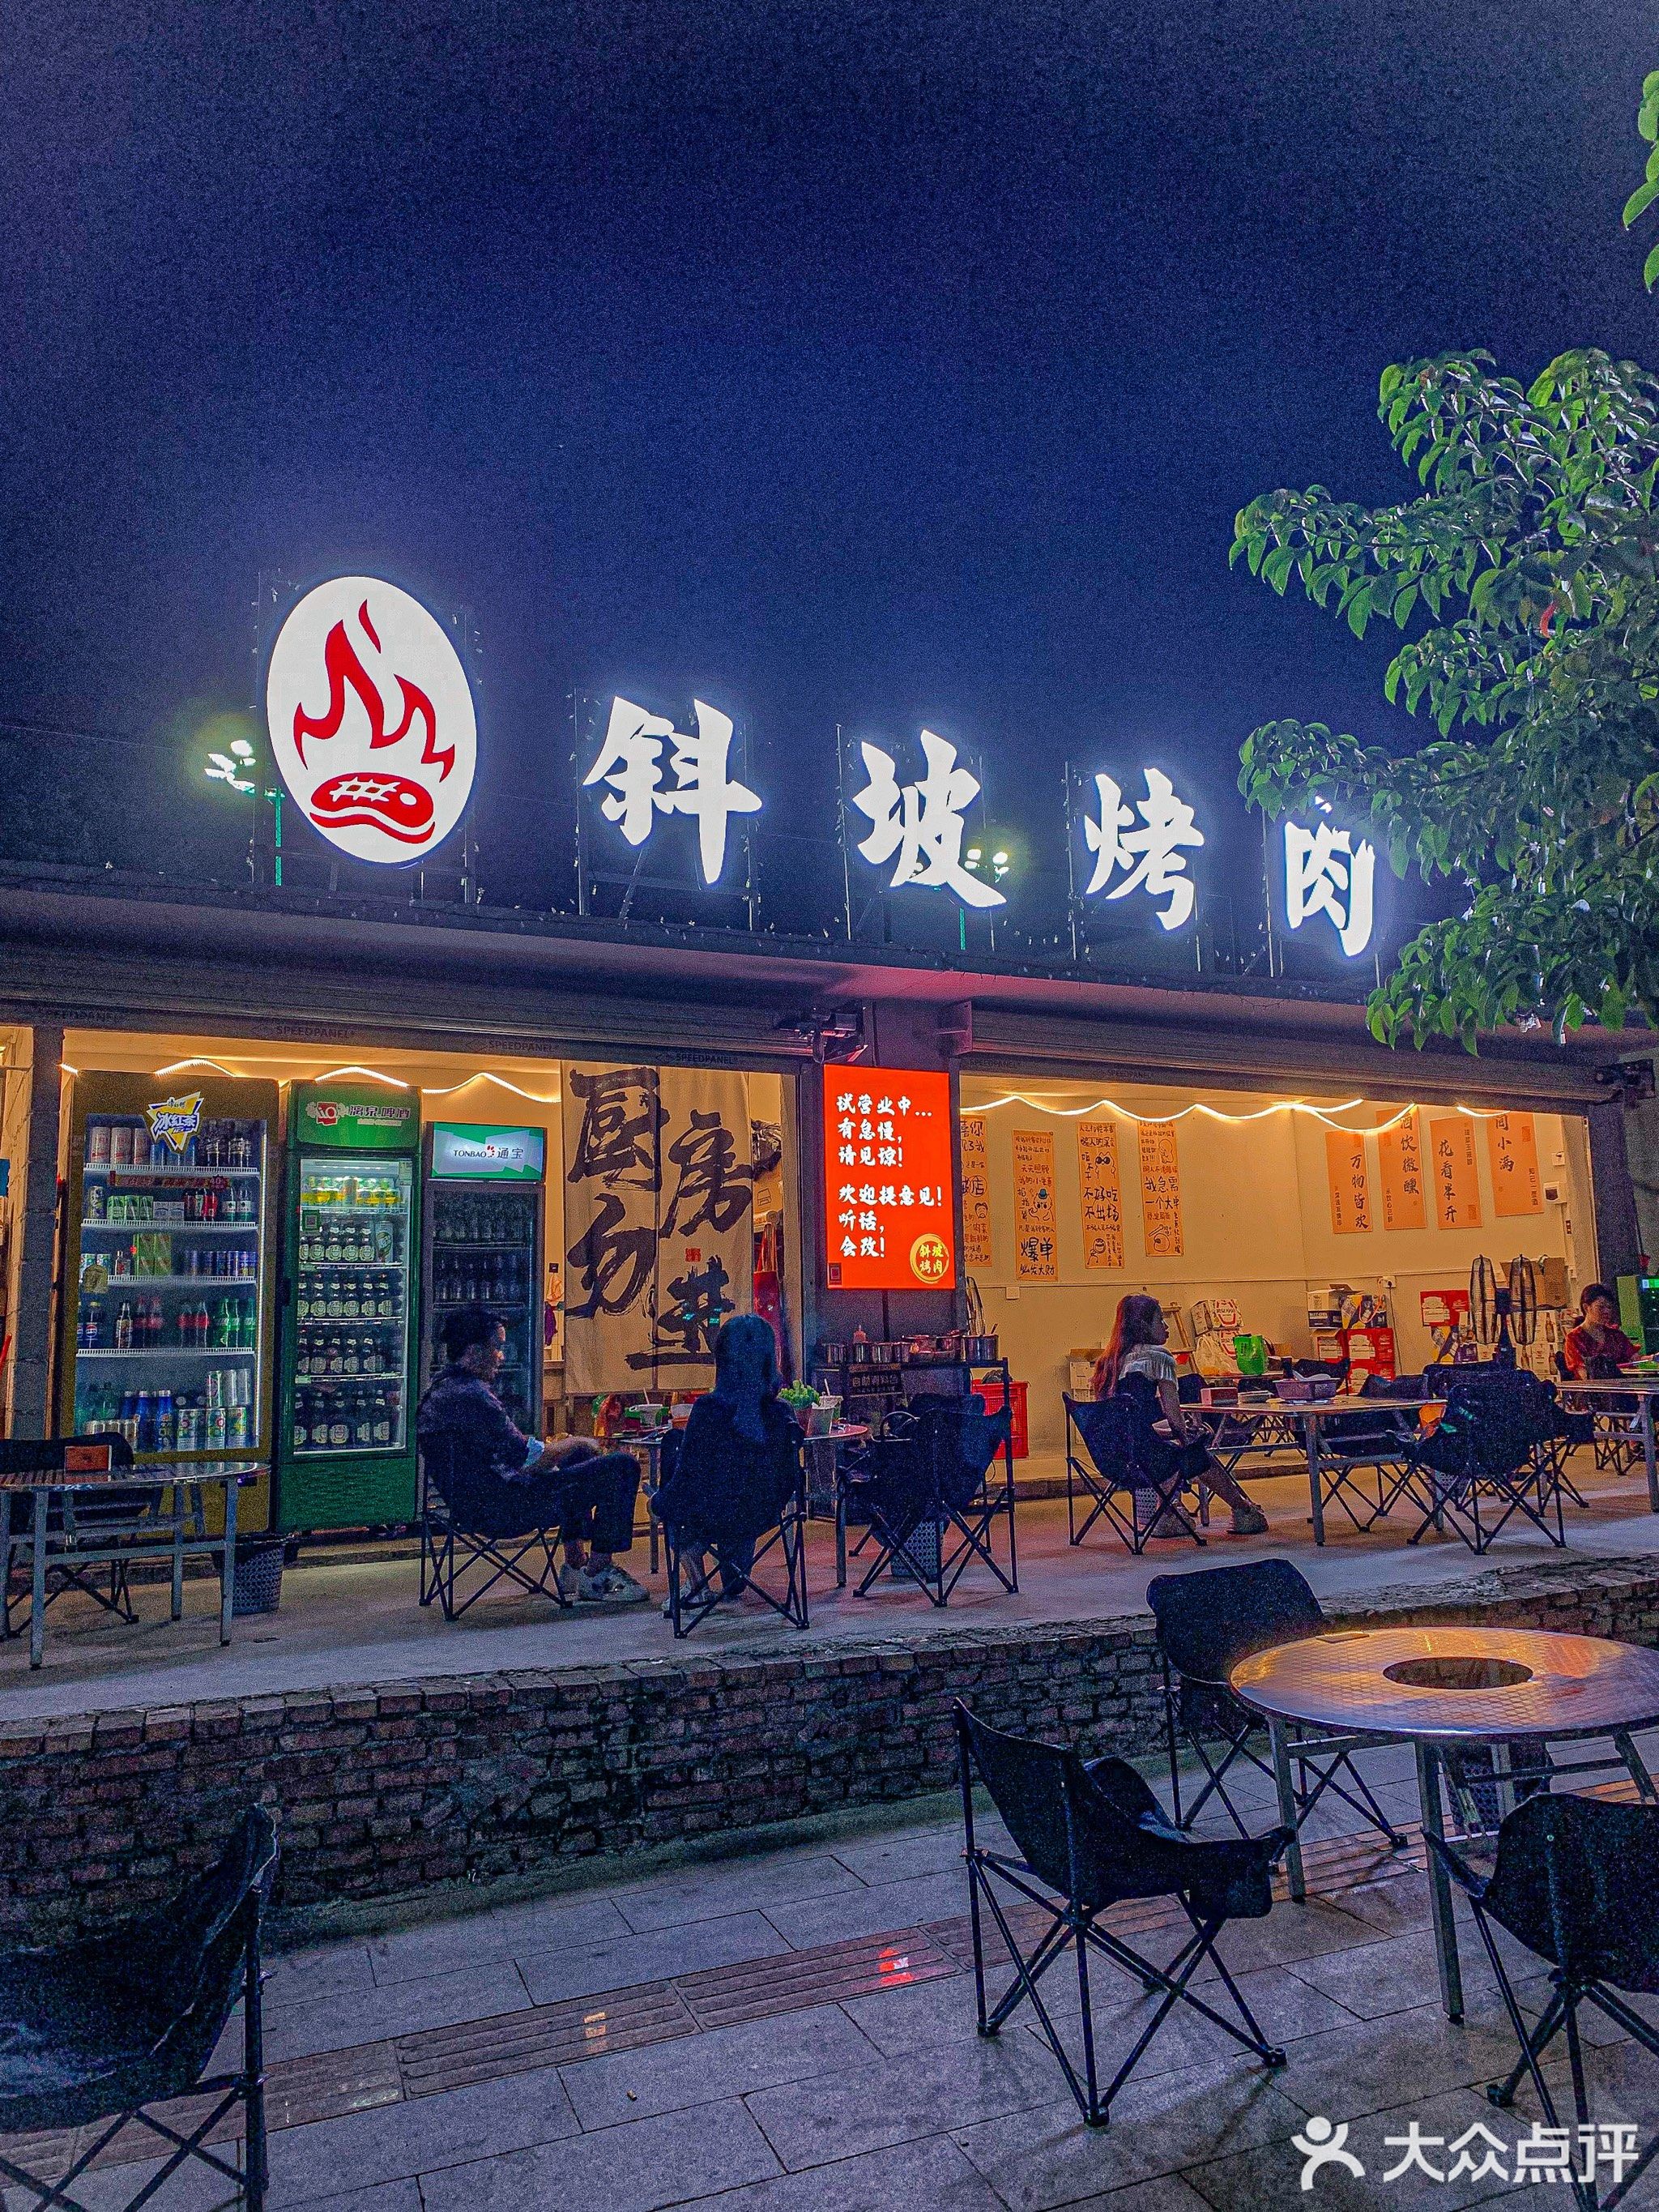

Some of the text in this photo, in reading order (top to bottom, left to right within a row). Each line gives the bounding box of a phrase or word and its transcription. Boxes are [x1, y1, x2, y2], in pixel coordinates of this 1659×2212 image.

[582, 695, 1375, 957] 斜坡烤肉
[349, 1105, 411, 1119] 漓泉啤酒
[153, 1112, 197, 1135] 冰红茶
[454, 1147, 524, 1159] TONBAO 通宝
[1400, 1112, 1420, 1195] 酒饮微醺
[1021, 1164, 1050, 1174] 天天照顾
[1144, 1175, 1179, 1194] 我急需
[1438, 1138, 1457, 1223] 花看半开
[1083, 1185, 1118, 1202] 不好吃
[1350, 1154, 1369, 1229] 万物皆欢
[1145, 1195, 1179, 1210] 一个大单
[1085, 1205, 1120, 1222] 不出场
[919, 1243, 945, 1258] 斜坡
[1020, 1236, 1054, 1262] 爆单
[919, 1259, 944, 1275] 烤肉
[1019, 1264, 1055, 1276] 必发大财
